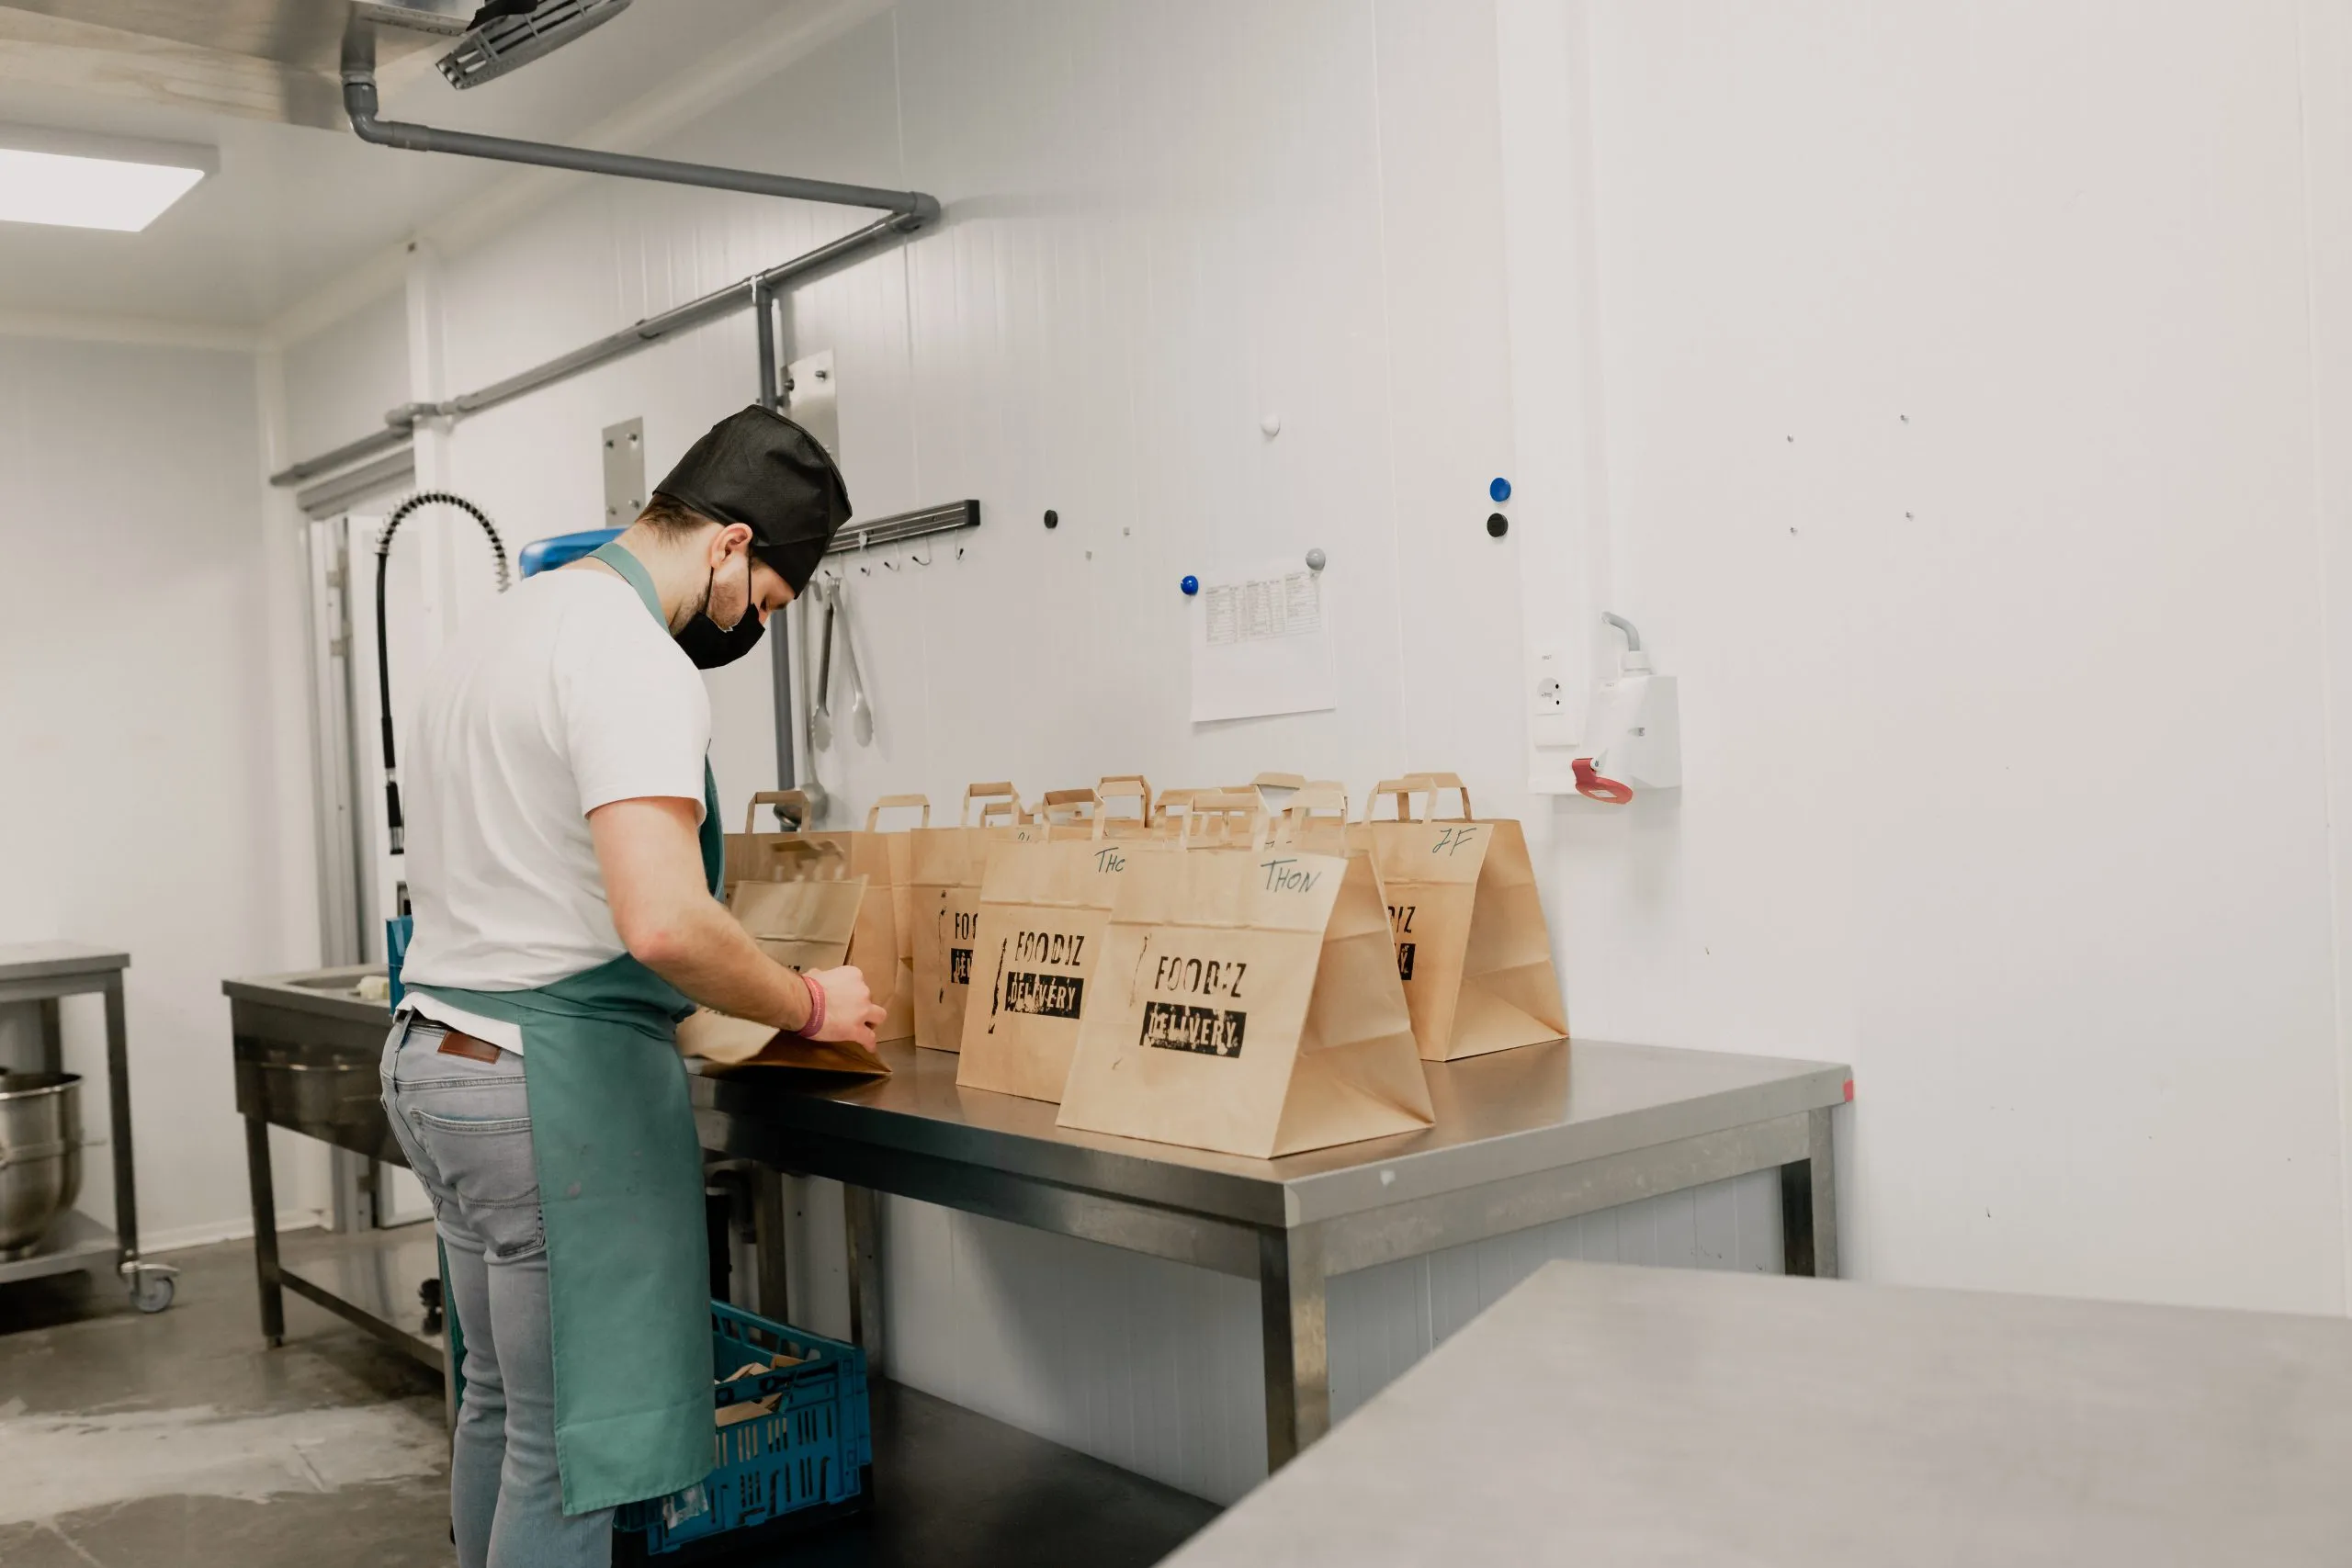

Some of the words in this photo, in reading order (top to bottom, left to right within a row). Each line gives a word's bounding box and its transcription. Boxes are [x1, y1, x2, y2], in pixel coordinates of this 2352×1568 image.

[1260, 859, 1322, 894] THON
[1009, 978, 1078, 1013] DELIVERY
[1147, 1011, 1238, 1050] DELIVERY
